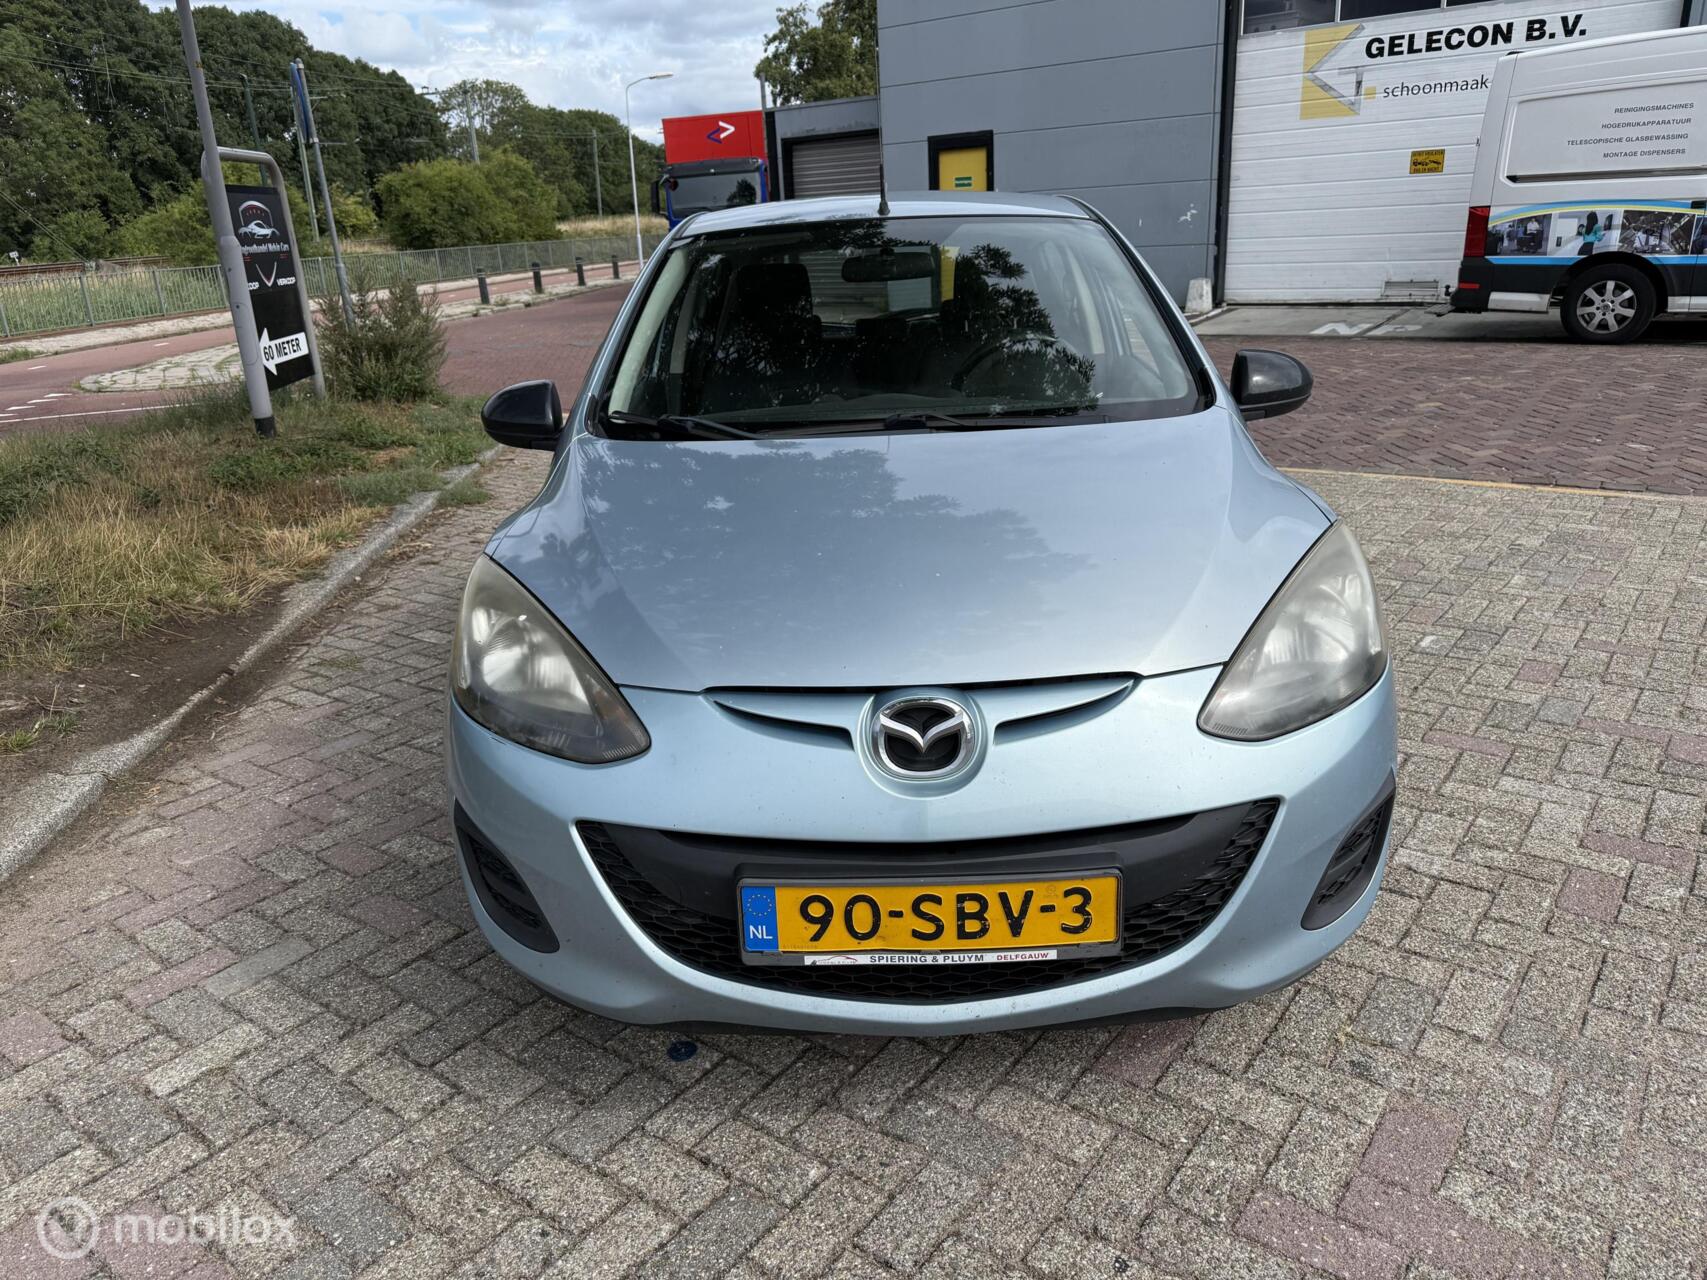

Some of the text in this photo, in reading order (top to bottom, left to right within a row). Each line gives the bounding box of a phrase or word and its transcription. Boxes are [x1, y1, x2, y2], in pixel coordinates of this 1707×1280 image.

[1365, 14, 1587, 59] GELECON B.V.
[1383, 74, 1489, 98] schoonmaak
[1614, 102, 1694, 114] REINIGINGSMACHINES
[1601, 118, 1692, 129] HOGEDRUKAPPARATUUR
[1567, 133, 1689, 146] TELESCOPISCHE GLASBEWASSING
[1603, 148, 1686, 159] MONTAGE DISPENSERS
[263, 337, 302, 362] 60 METER
[799, 886, 1093, 942] 90-SBV-3
[749, 925, 773, 940] NL
[870, 952, 1049, 964] SPIERING & PLUYM DELFGAUW
